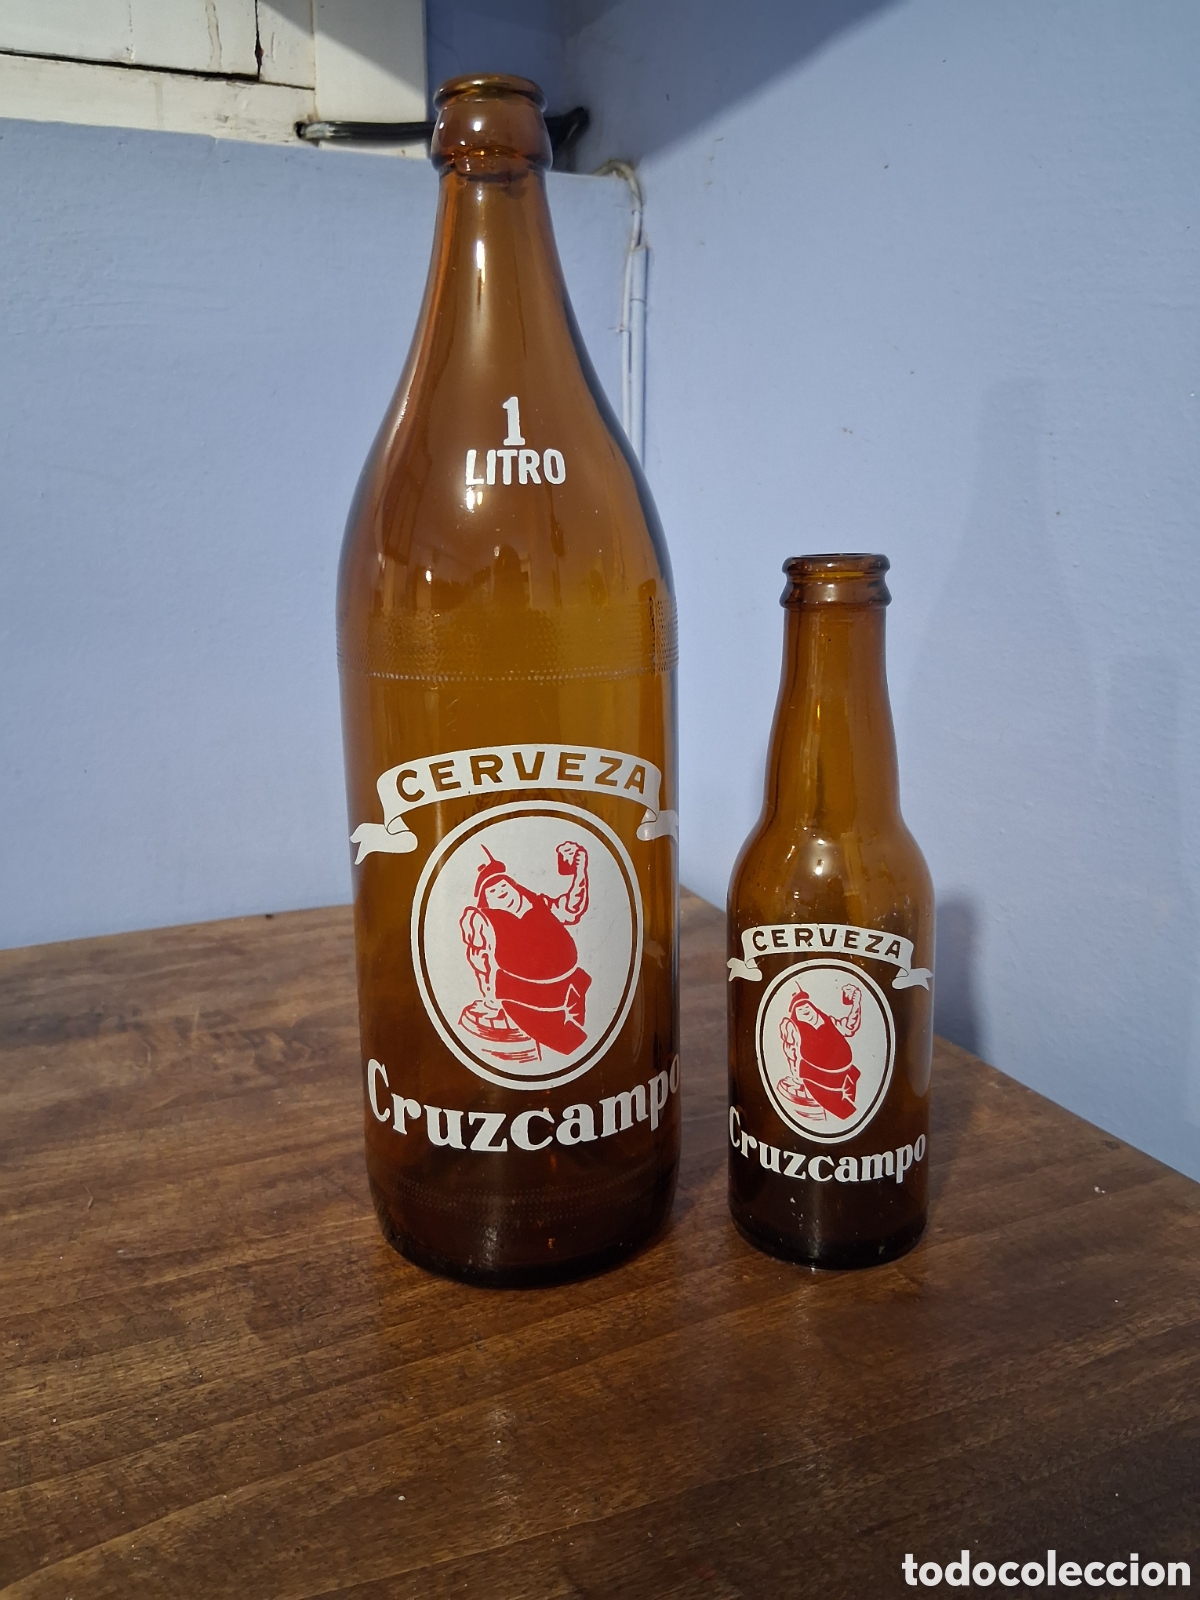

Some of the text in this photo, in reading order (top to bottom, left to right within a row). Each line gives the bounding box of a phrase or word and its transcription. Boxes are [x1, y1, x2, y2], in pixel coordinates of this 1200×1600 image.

[502, 396, 526, 446] 1
[465, 449, 567, 485] LITRO
[396, 751, 647, 802] CERVEZA
[752, 927, 902, 960] CERVEZA
[367, 1053, 680, 1152] Cruzcampo
[729, 1106, 926, 1184] Cruzcampo
